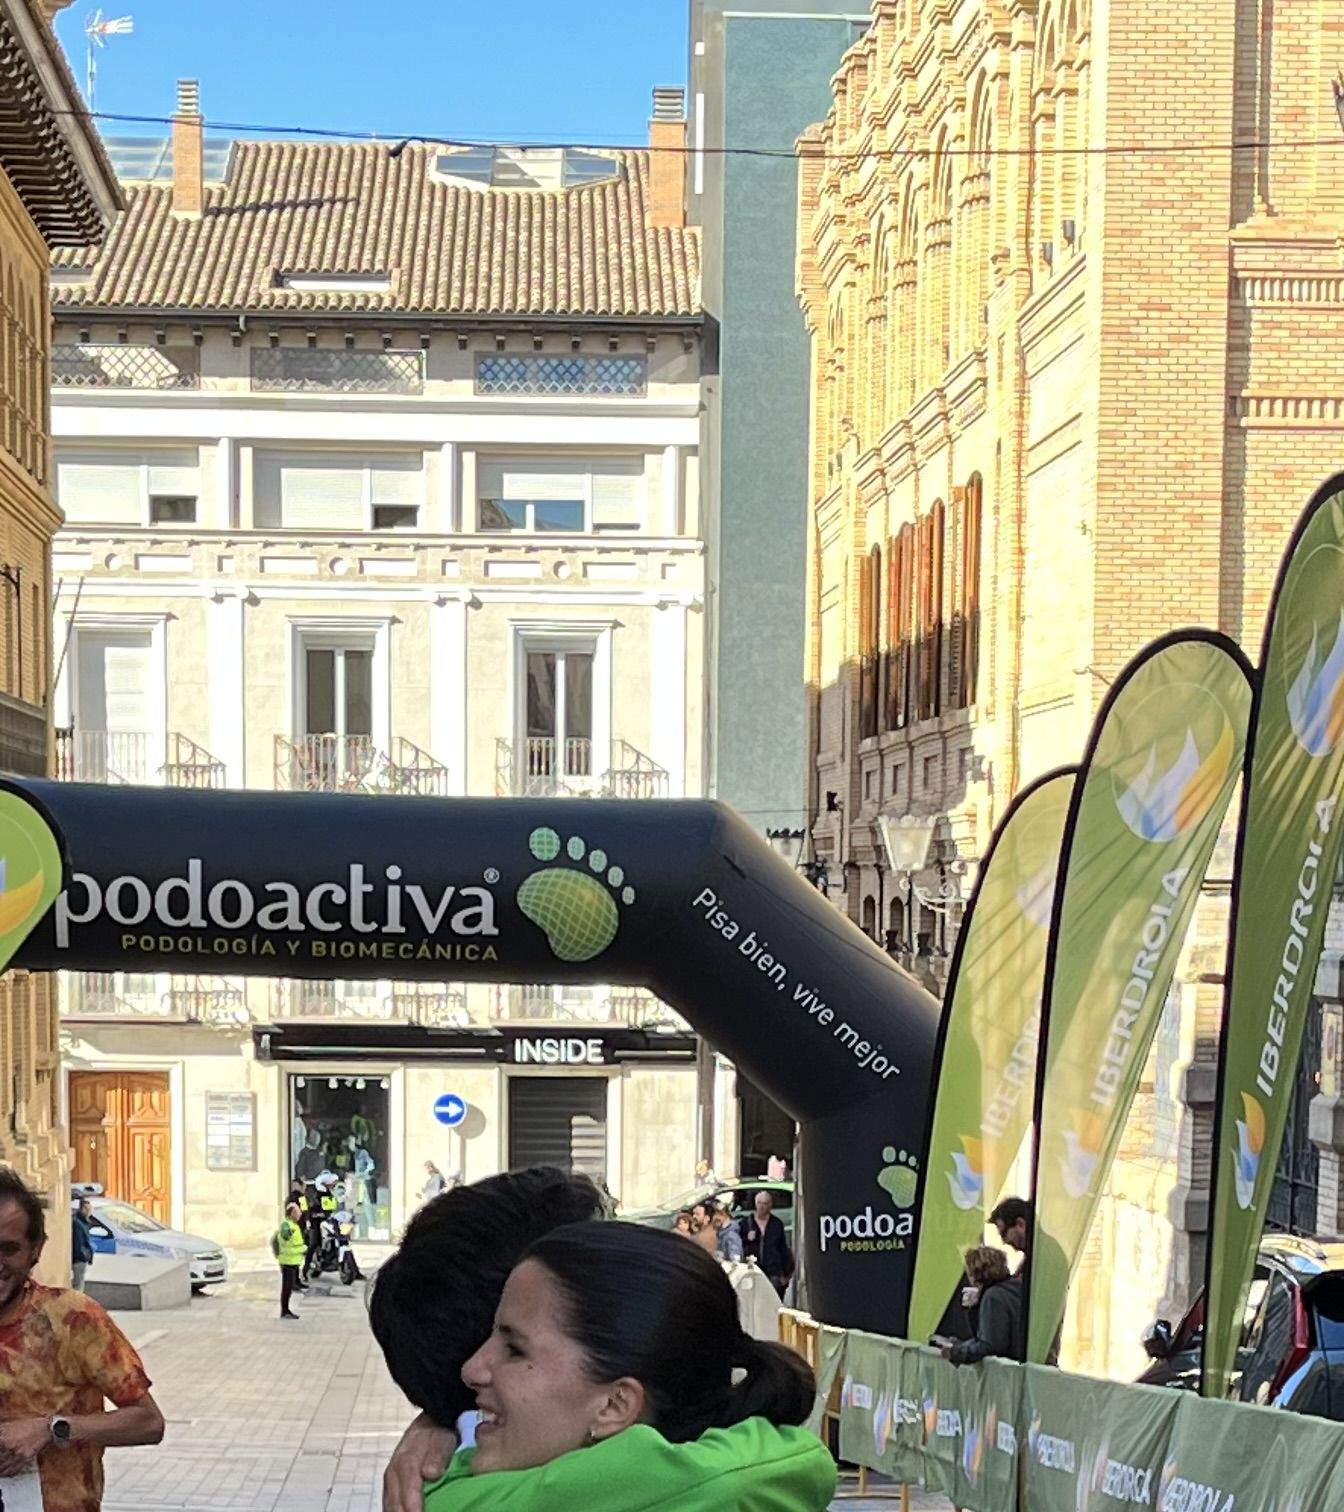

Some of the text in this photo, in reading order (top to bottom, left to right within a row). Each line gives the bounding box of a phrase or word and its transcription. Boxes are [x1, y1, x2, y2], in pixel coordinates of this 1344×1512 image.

[286, 940, 301, 956] Y
[311, 937, 498, 961] BIOMECÁNICA
[692, 887, 901, 1079] Pisa bien, vive mejor
[514, 1038, 605, 1064] INSIDE
